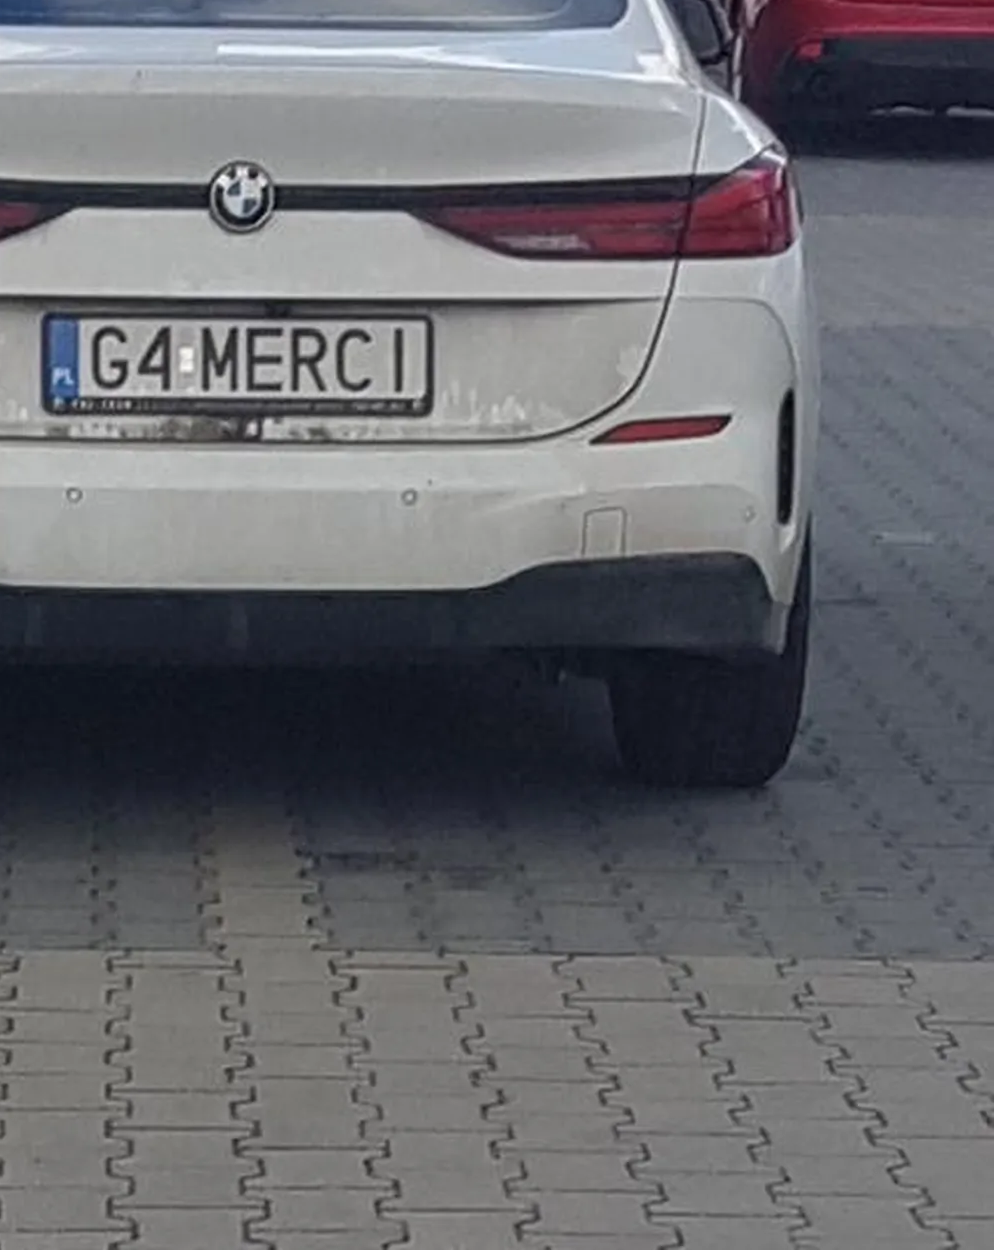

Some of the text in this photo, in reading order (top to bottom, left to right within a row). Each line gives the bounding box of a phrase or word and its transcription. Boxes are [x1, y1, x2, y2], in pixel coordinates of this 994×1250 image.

[52, 367, 75, 386] PL
[91, 326, 404, 393] G4 MERCI
